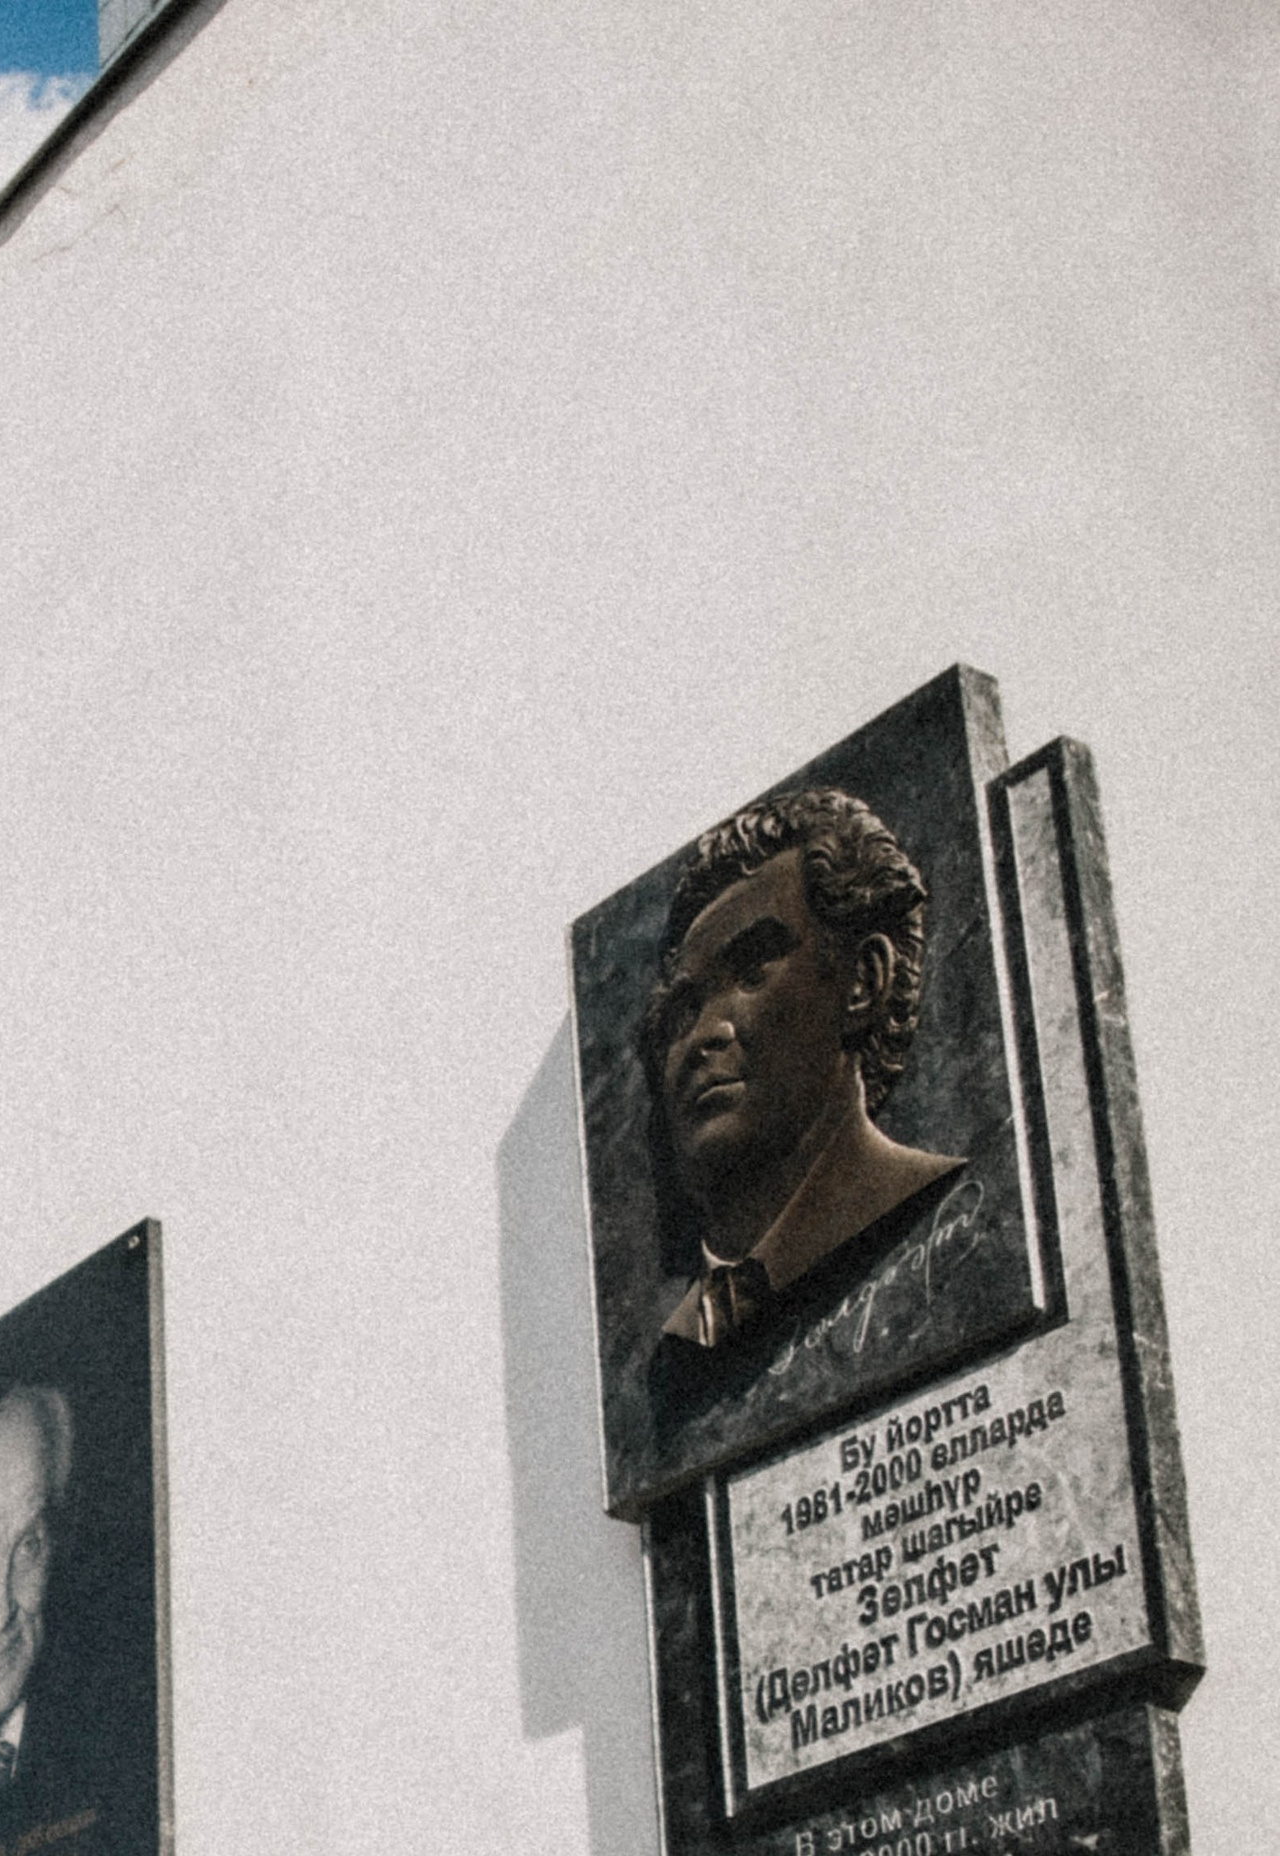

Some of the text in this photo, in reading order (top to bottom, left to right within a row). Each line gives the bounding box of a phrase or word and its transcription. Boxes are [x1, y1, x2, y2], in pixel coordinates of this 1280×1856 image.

[780, 1389, 1068, 1537] 1981-2000 елларда
[839, 1384, 992, 1473] Бу йортта
[809, 1480, 1044, 1600] татар шагыйре
[860, 1466, 983, 1541] мәшһүр
[856, 1542, 1002, 1627] Зөлфәт
[906, 1577, 1038, 1658] Госман
[1043, 1543, 1127, 1614] улы
[789, 1609, 1093, 1750] Маликов) яшәде
[827, 1806, 903, 1852] этом
[913, 1774, 999, 1828] доме
[943, 1826, 979, 1854] гг.
[988, 1797, 1060, 1840] жил
